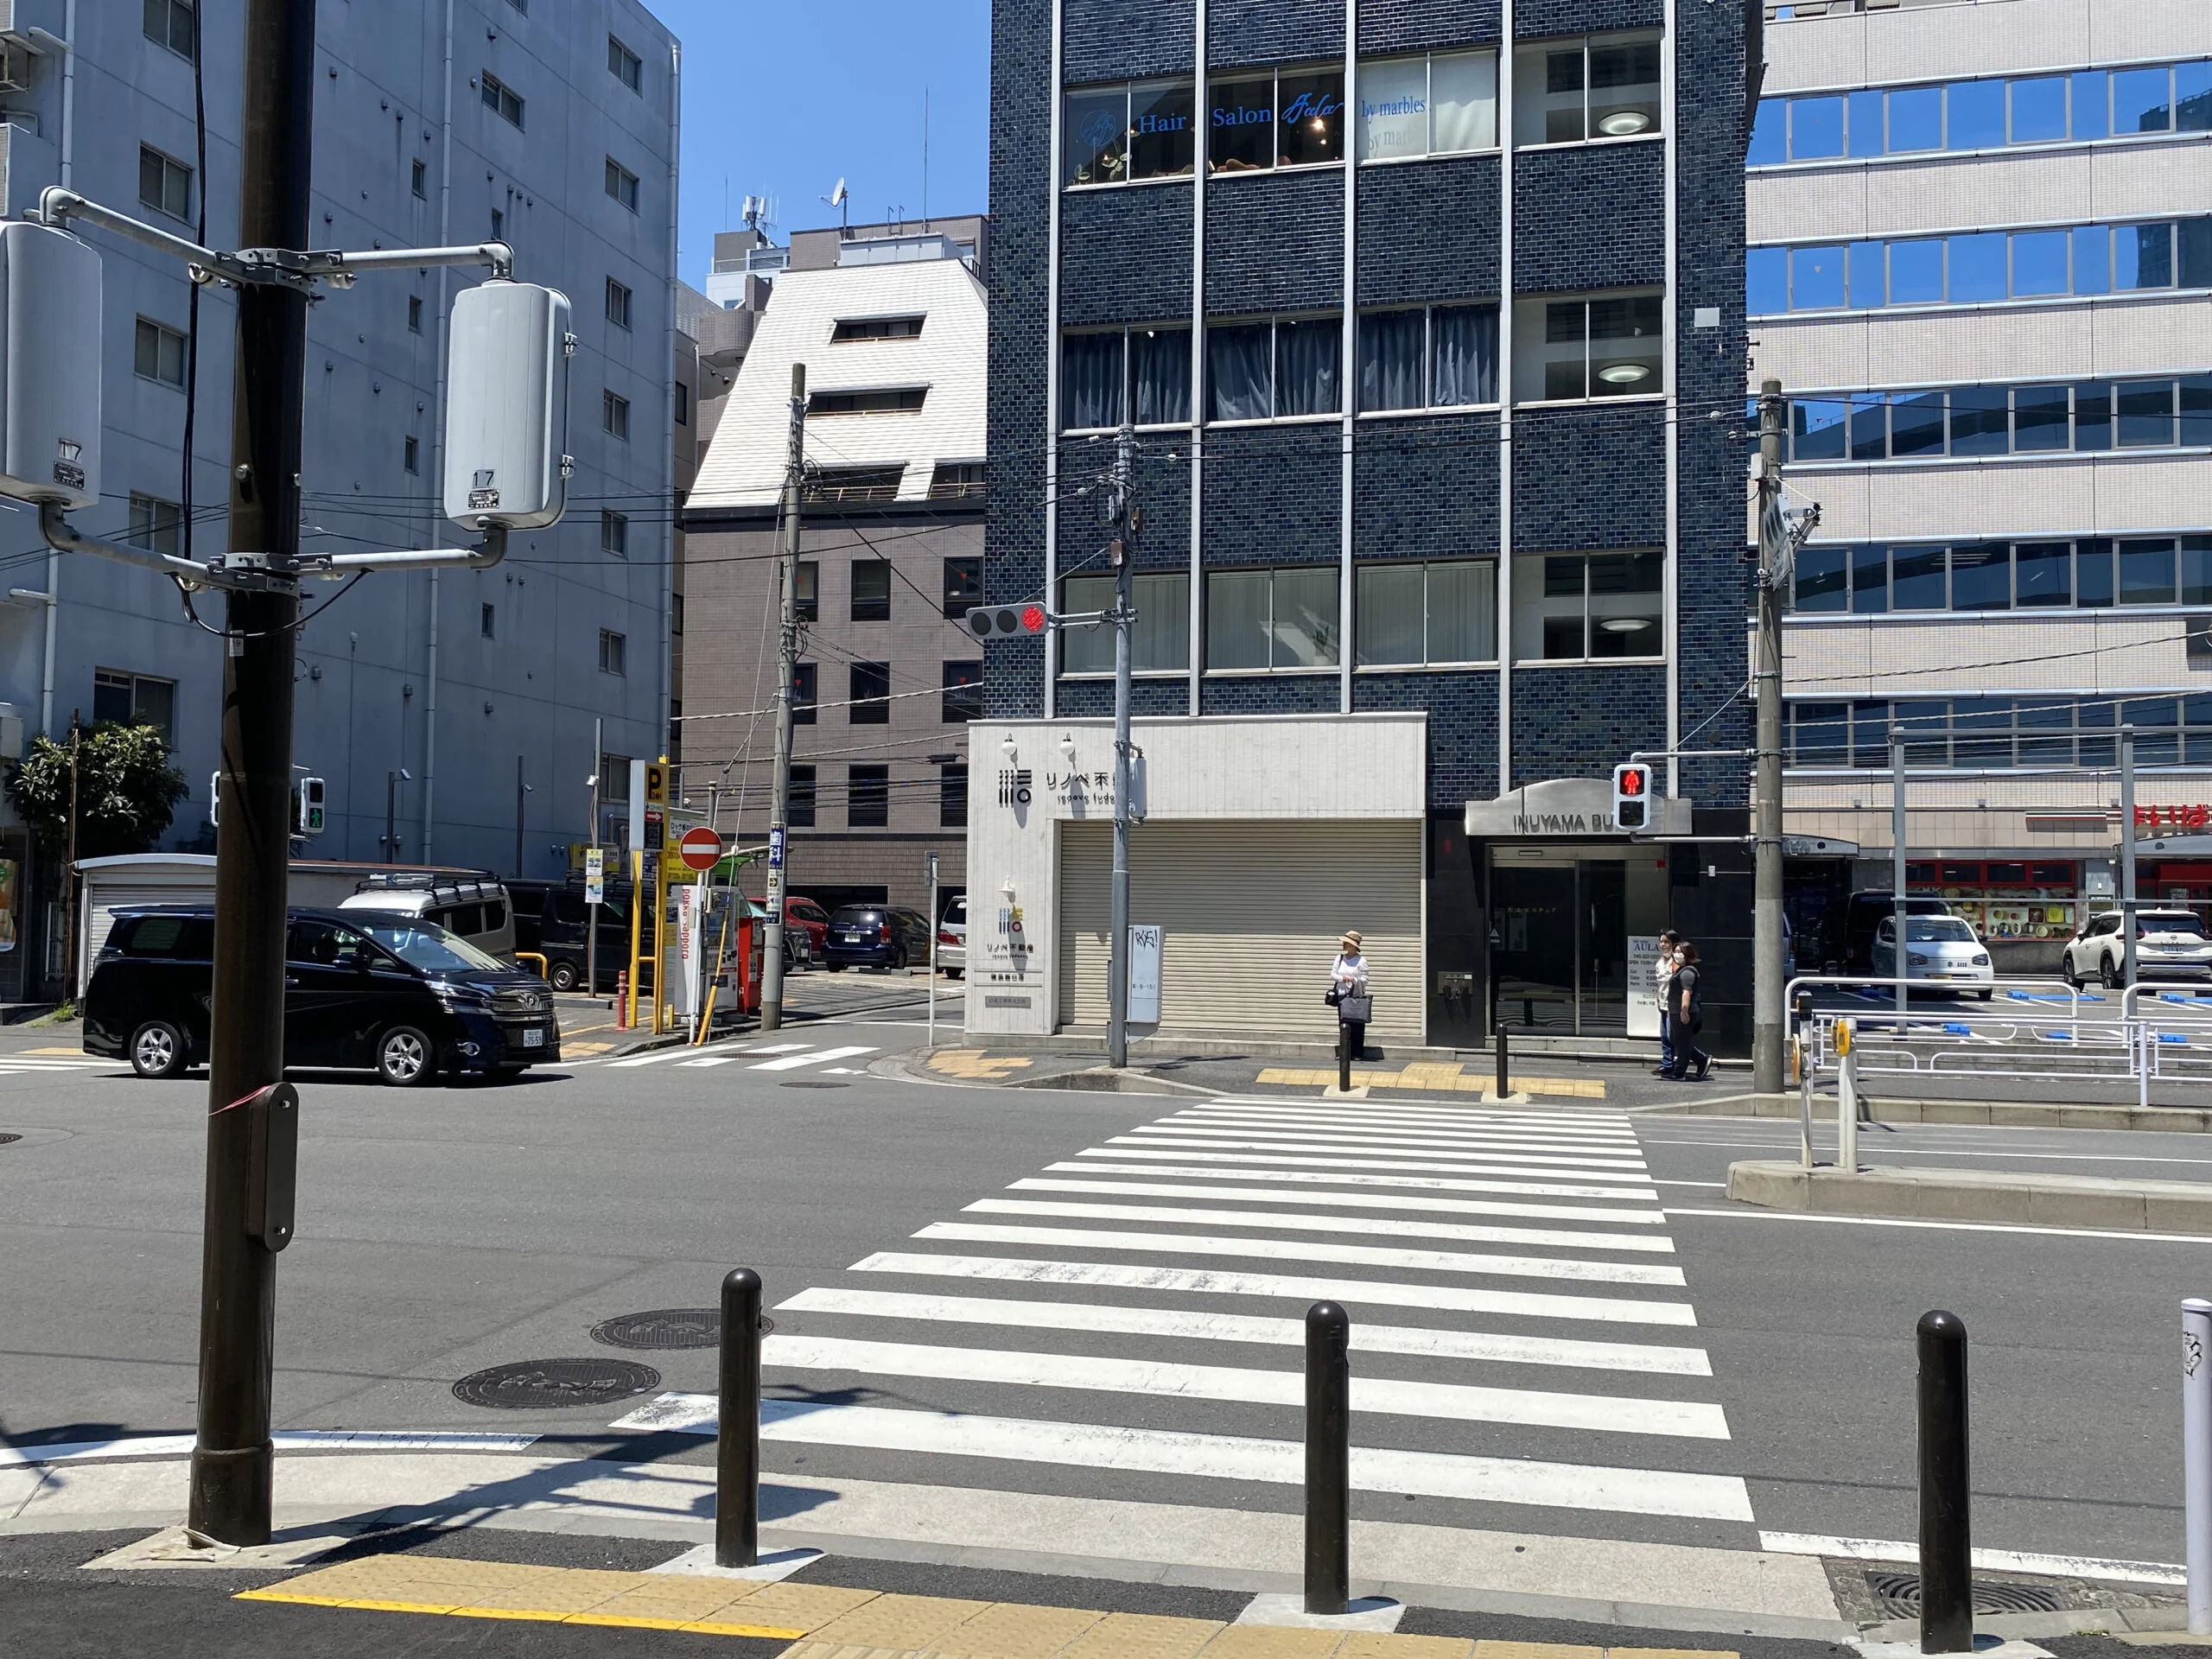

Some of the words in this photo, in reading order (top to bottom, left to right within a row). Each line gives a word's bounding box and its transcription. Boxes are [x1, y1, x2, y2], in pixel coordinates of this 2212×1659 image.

[1139, 113, 1186, 134] Hair
[1212, 105, 1273, 127] Salon
[1361, 99, 1376, 124] by
[1379, 95, 1426, 116] marbles
[60, 440, 82, 461] 17
[473, 471, 494, 487] 17
[648, 767, 661, 800] P
[1046, 771, 1115, 791] リノベ不
[1093, 792, 1115, 803] fudo
[1513, 814, 1586, 834] INUYAMA
[1592, 814, 1618, 833] BU
